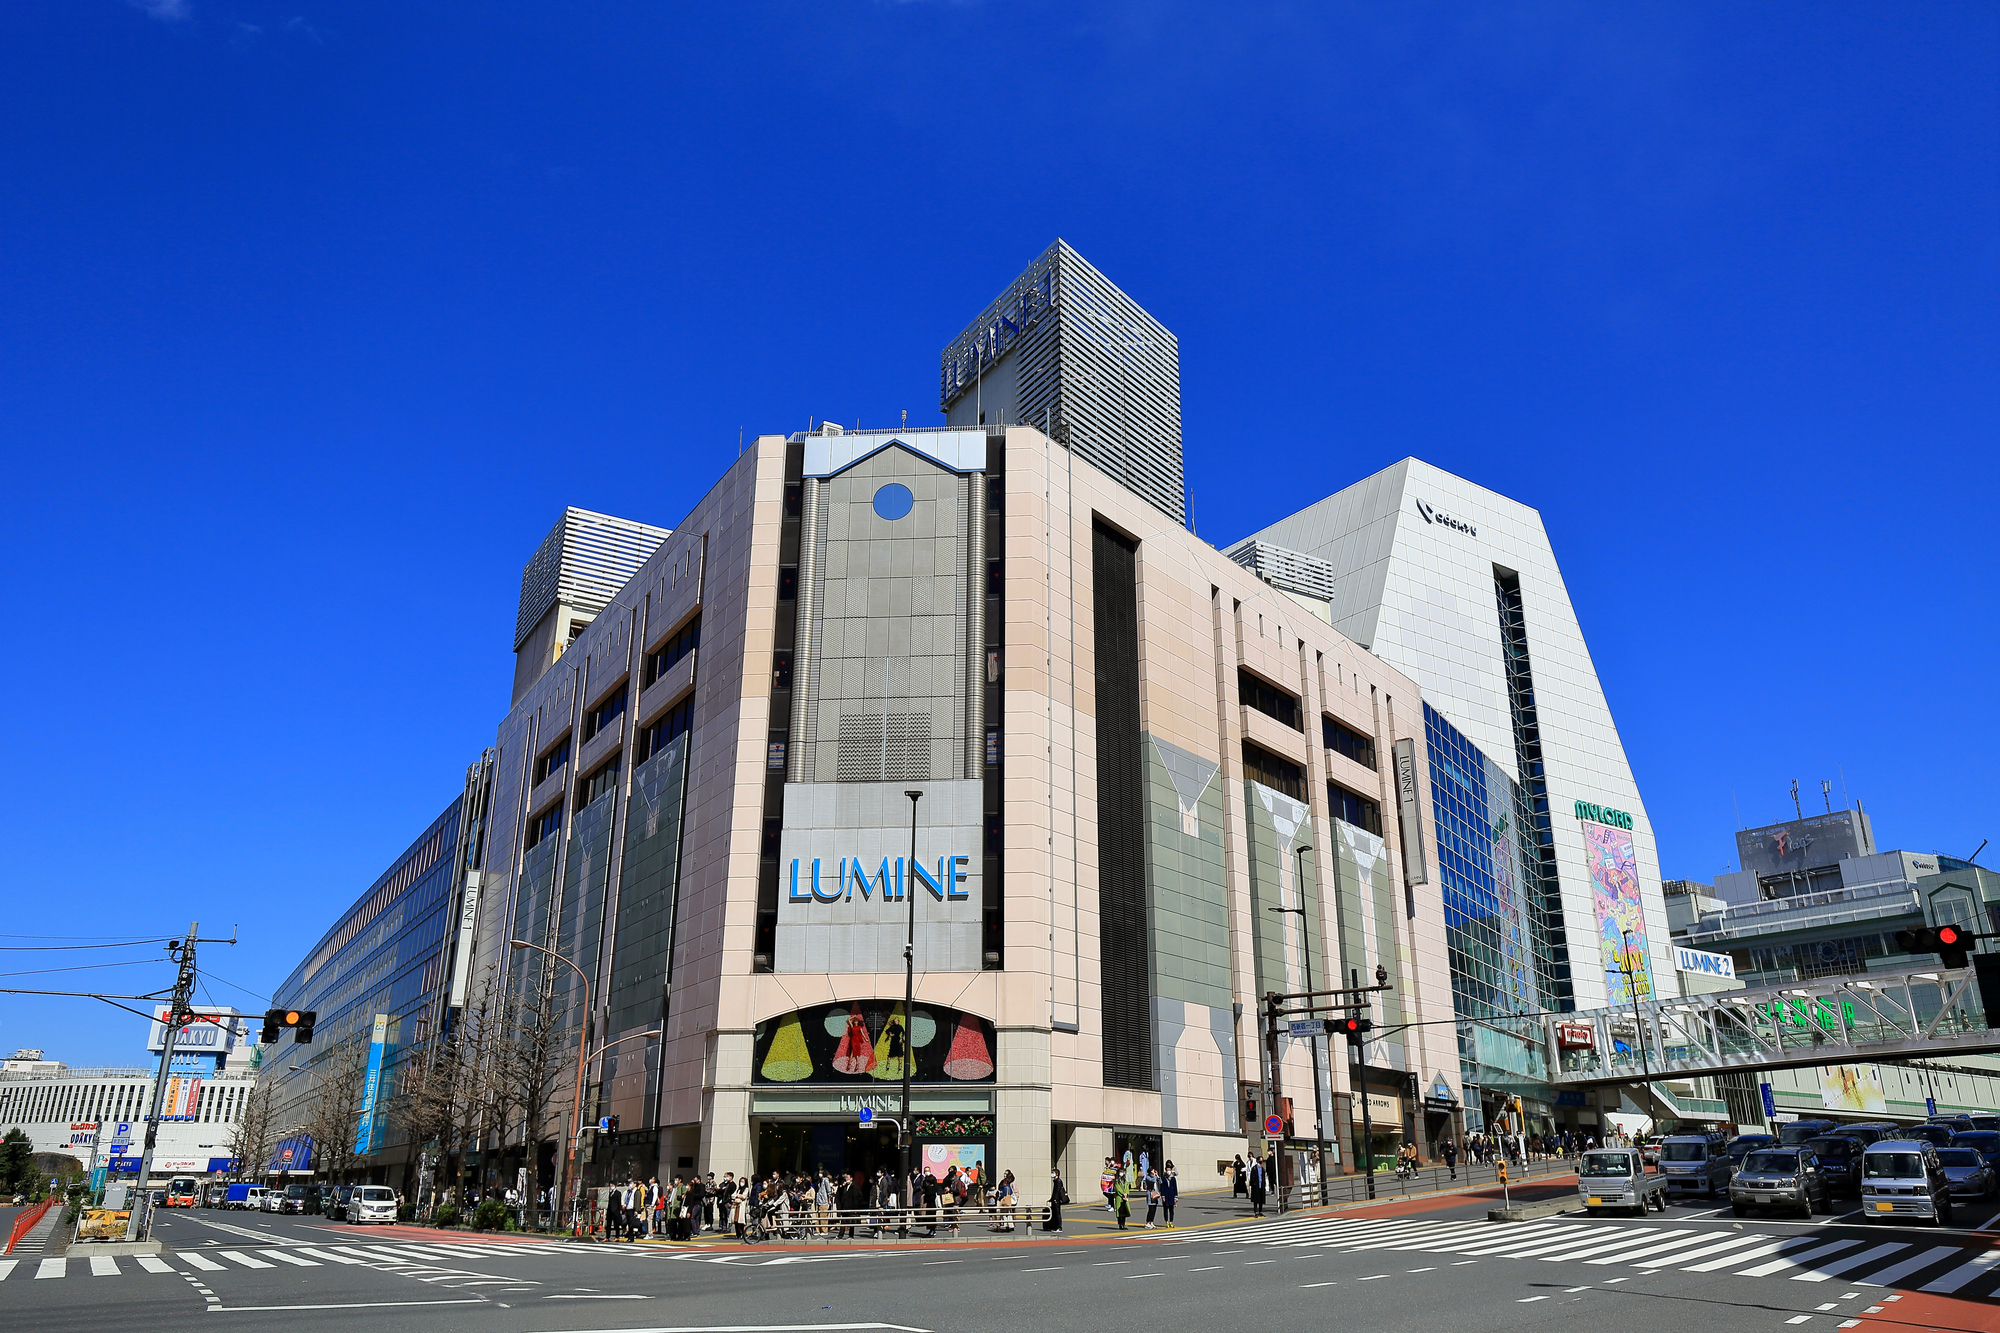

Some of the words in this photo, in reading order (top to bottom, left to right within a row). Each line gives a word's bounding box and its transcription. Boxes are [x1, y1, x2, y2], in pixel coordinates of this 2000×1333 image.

[1399, 755, 1414, 796] LUMINE
[788, 855, 970, 903] LUMINE
[463, 885, 478, 922] LUMINE
[1680, 950, 1723, 976] LUMINE
[1722, 957, 1732, 976] 2
[840, 1094, 895, 1113] LUMINE
[117, 1124, 129, 1136] P
[98, 1155, 105, 1163] P
